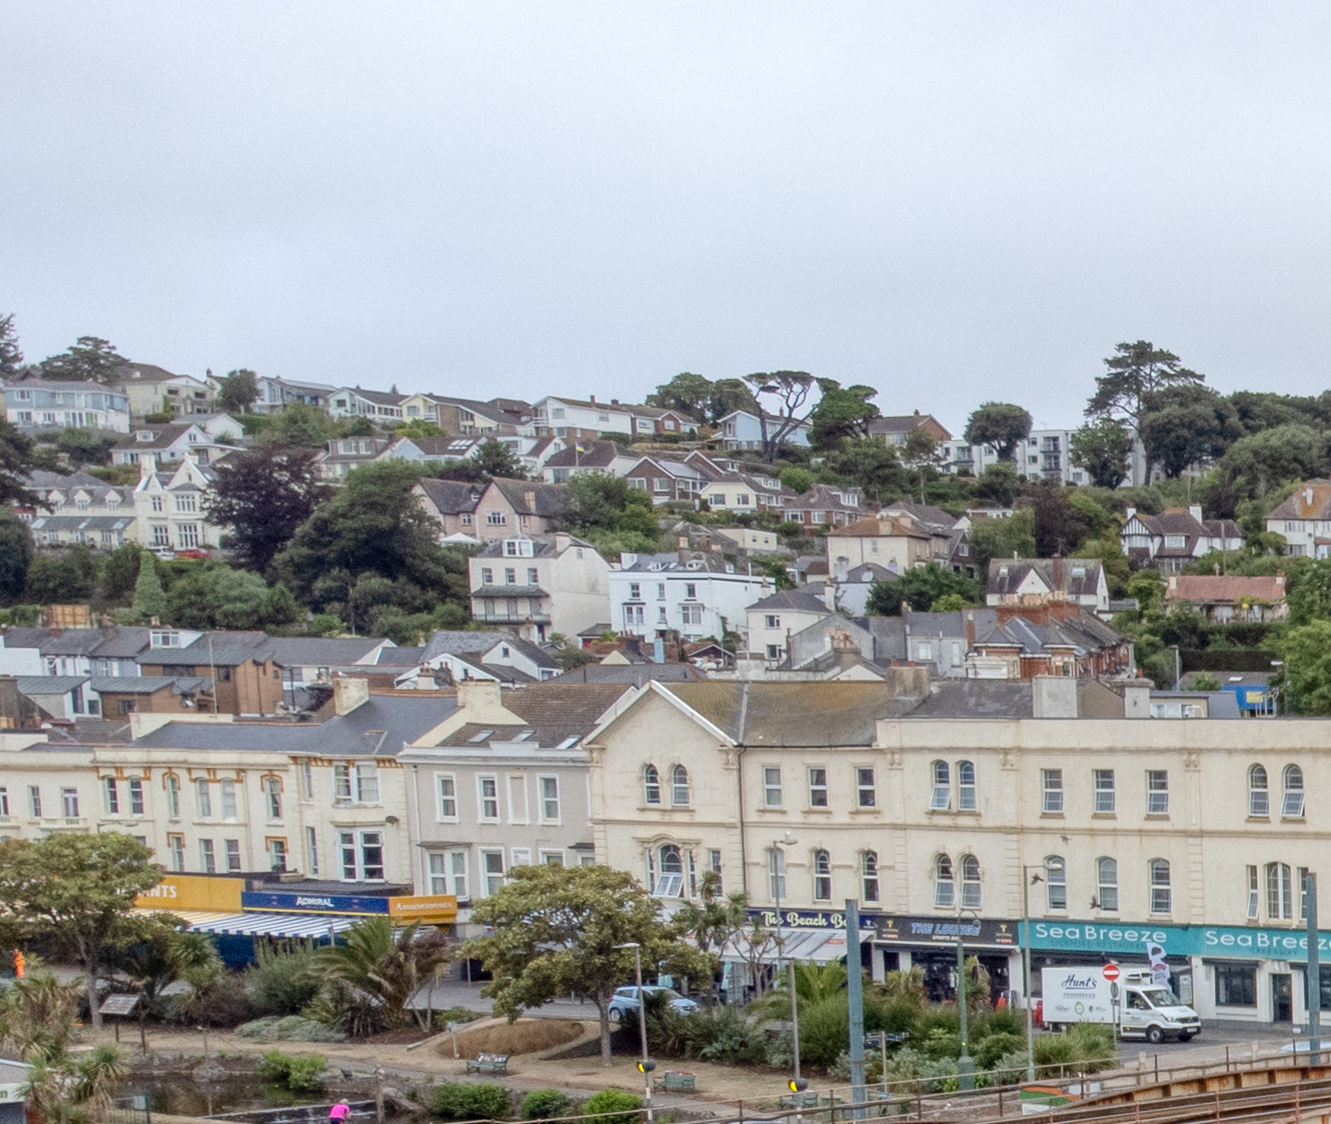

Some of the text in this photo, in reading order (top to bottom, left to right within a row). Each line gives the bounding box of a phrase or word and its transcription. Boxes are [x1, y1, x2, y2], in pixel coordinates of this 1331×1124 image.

[396, 902, 452, 910] Amusements
[761, 911, 784, 926] The
[787, 912, 828, 927] Beach
[911, 922, 933, 934] THE
[934, 924, 981, 936] LOUNGE
[1035, 924, 1167, 943] Sea Breeze
[1205, 930, 1252, 946] Sea
[1061, 974, 1097, 988] Hunt's
